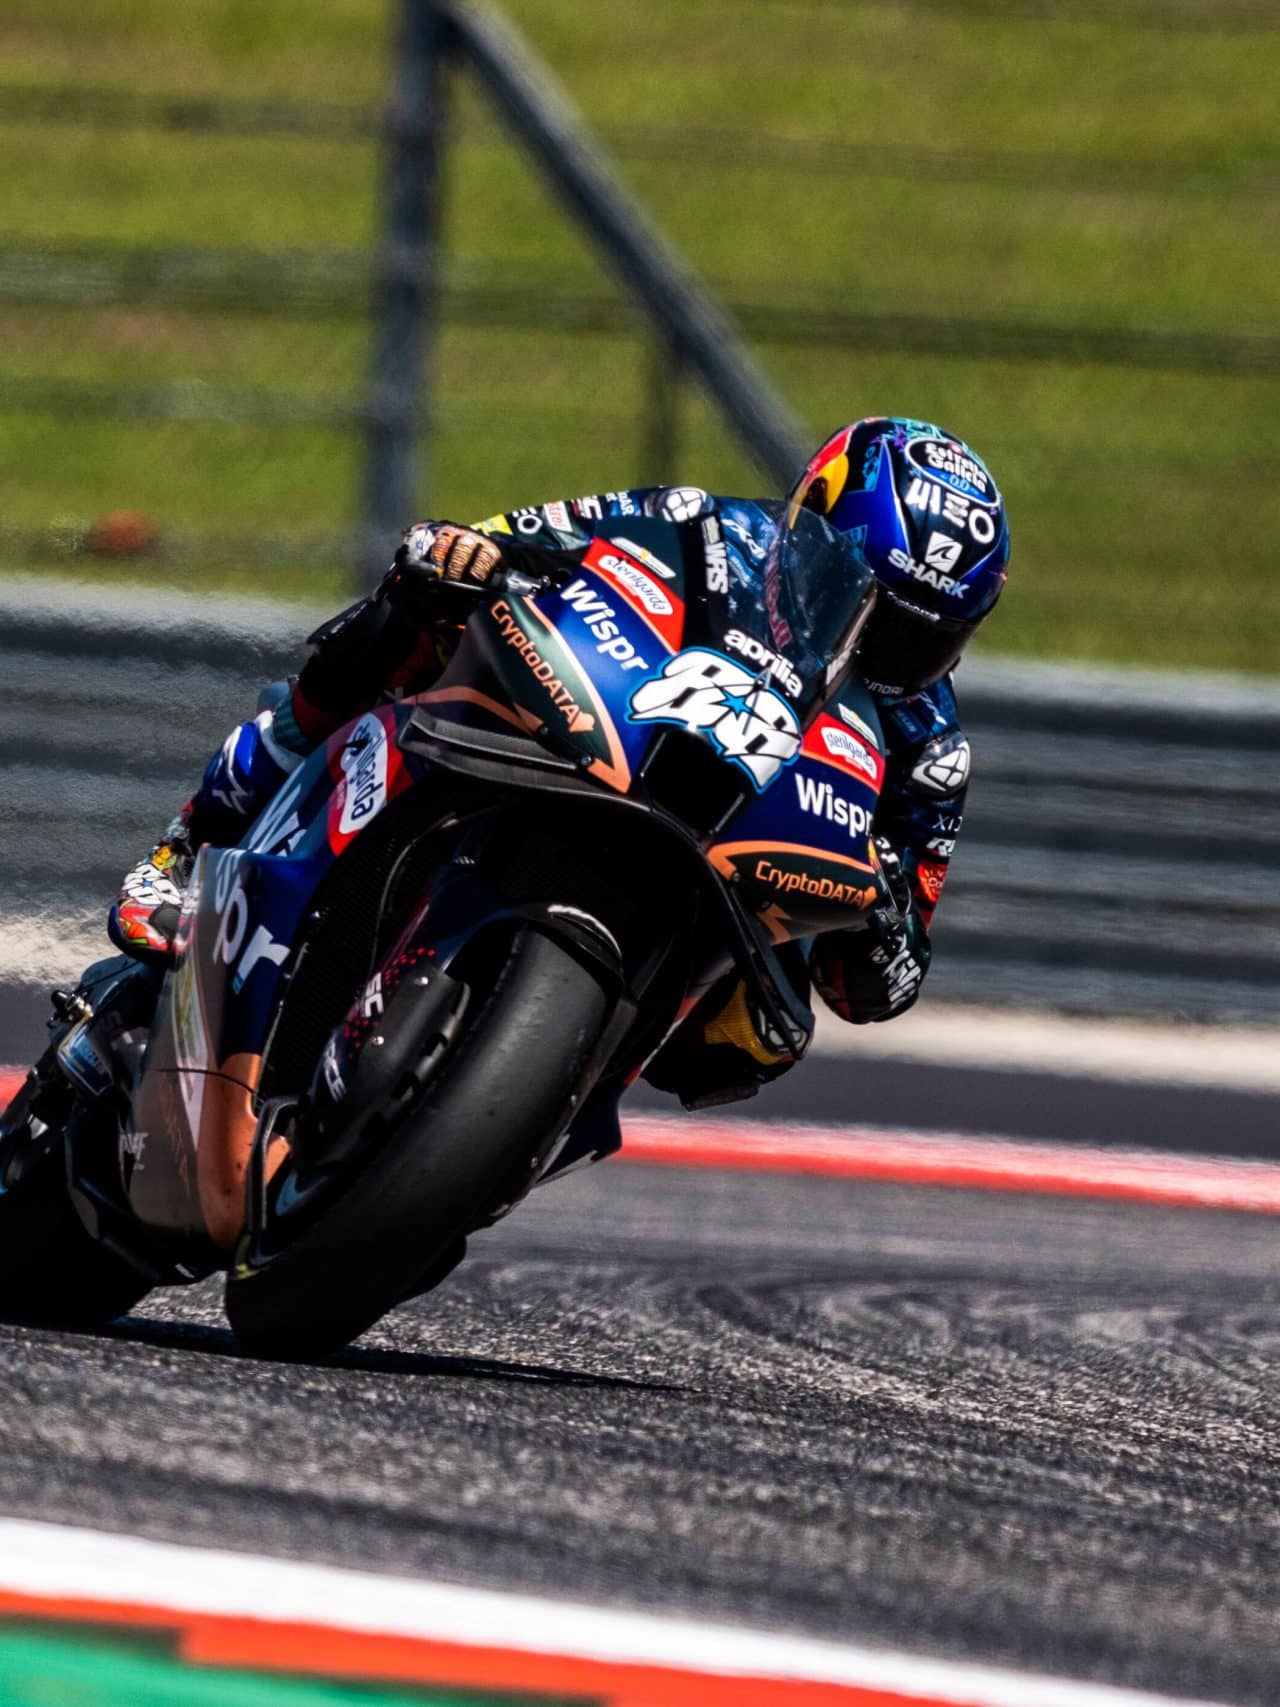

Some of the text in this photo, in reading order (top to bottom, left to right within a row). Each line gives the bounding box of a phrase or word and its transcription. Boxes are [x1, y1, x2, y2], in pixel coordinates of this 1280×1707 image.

[927, 453, 988, 494] Galicia
[703, 541, 730, 594] WRS
[887, 547, 971, 600] SHARK
[560, 579, 649, 672] Wispr
[490, 600, 586, 727] CryptoDATA
[723, 628, 803, 698] aprilia
[794, 772, 874, 838] Wispr
[755, 859, 868, 909] CryptoDATA
